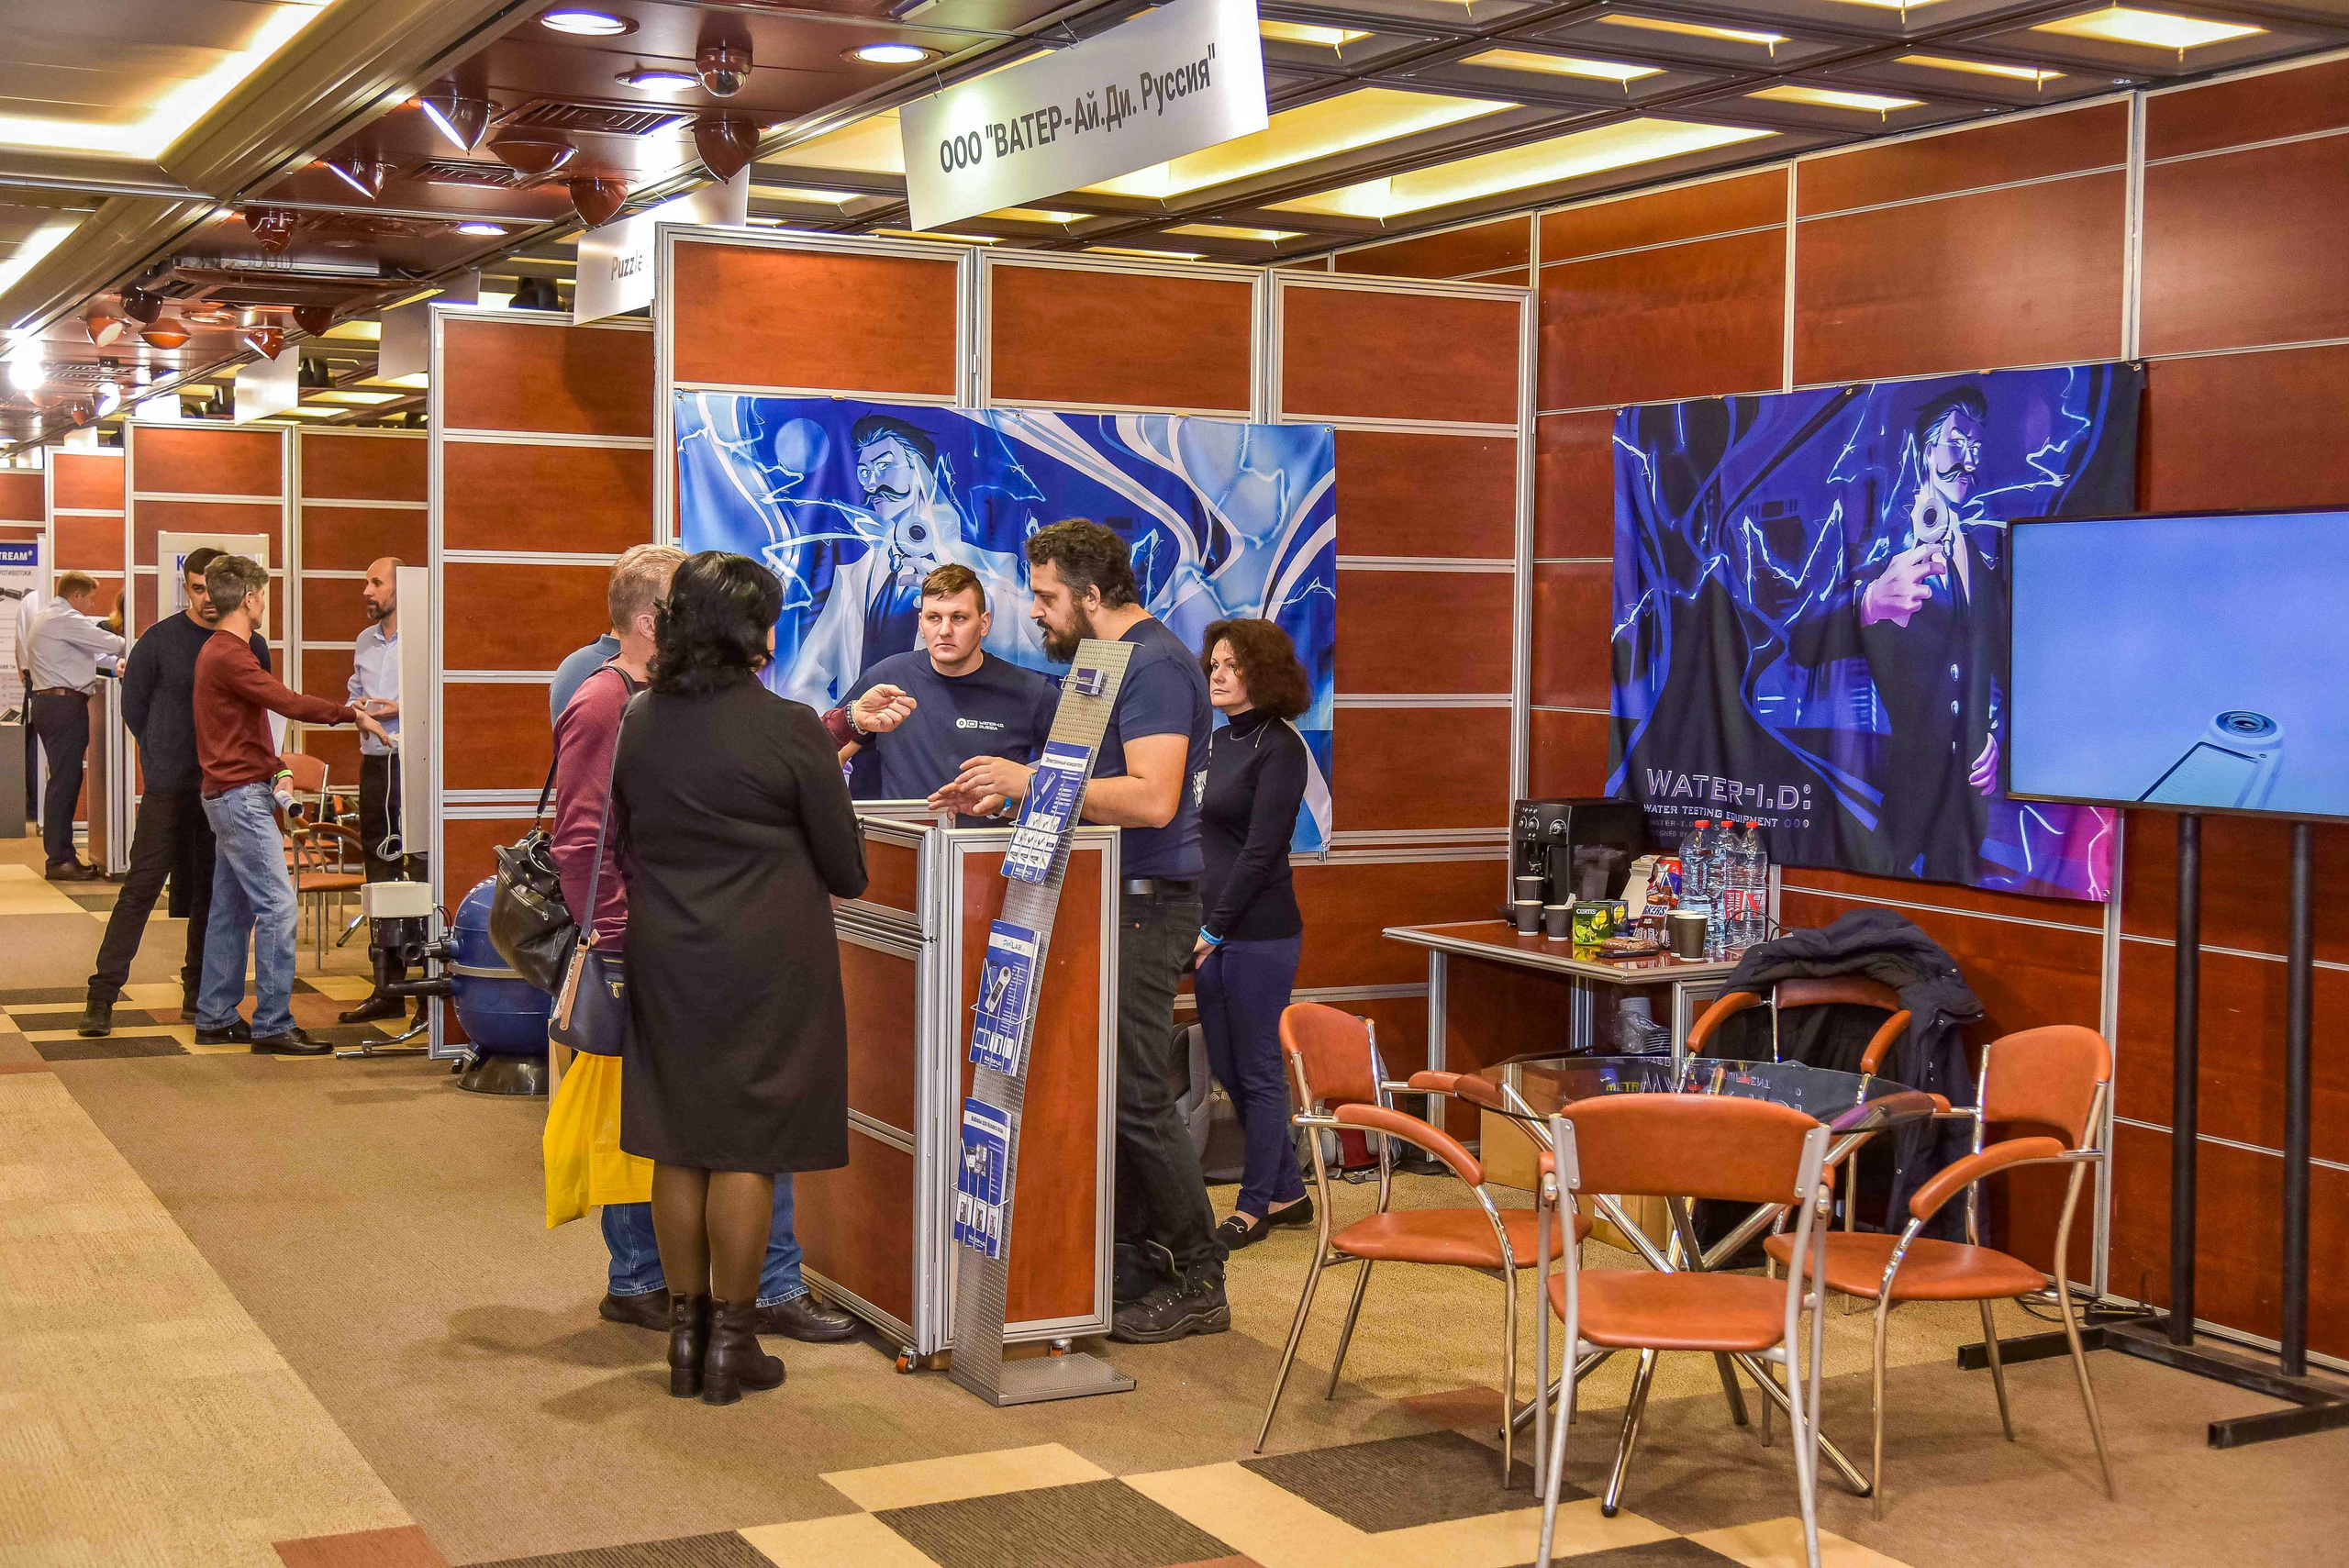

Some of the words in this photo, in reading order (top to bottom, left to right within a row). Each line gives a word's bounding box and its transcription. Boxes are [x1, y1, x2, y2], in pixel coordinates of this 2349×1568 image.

[940, 130, 983, 173] ООО
[1140, 43, 1216, 117] Руссия"
[1643, 803, 1678, 815] WATER
[1681, 806, 1723, 818] TESTING
[1726, 811, 1778, 828] EQUIPMENT
[1606, 1082, 1641, 1092] METR
